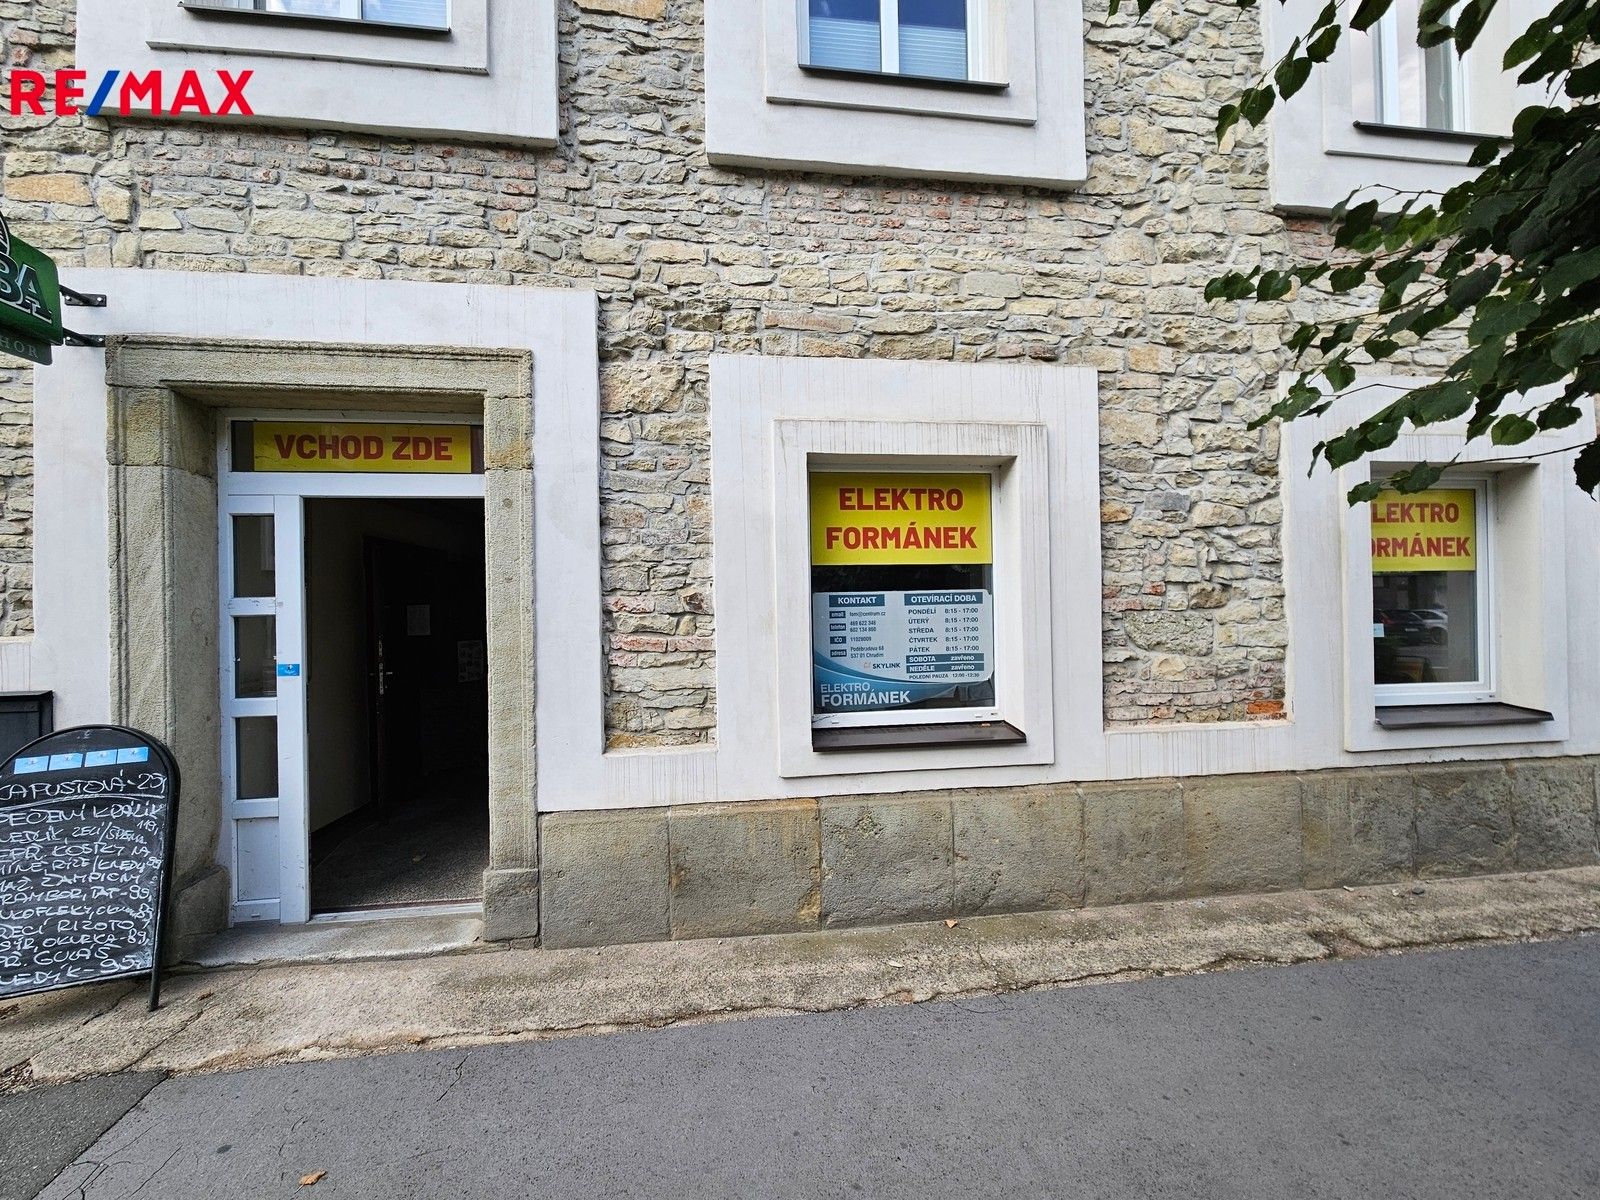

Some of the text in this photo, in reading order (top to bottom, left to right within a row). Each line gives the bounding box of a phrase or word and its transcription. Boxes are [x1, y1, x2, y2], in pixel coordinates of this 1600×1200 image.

[274, 434, 453, 461] VCHOD ZDE
[839, 487, 964, 511] ELEKTRO
[1371, 503, 1460, 523] LEKTRO
[826, 522, 977, 550] FORMÁNEK
[911, 593, 977, 603] OTEVÍRACÍ DOBA
[908, 607, 937, 615] PONDĚLÍ
[908, 617, 929, 625] ÚTERÝ
[908, 626, 934, 634] STŘEDA
[908, 636, 938, 644] ČTVRTEK
[909, 645, 930, 653] PÁTEK
[872, 662, 901, 670] SKYLINK
[909, 664, 935, 672] NEDĚLE
[820, 682, 871, 693] ELEKTRO
[821, 688, 911, 707] FORMÁNEK
